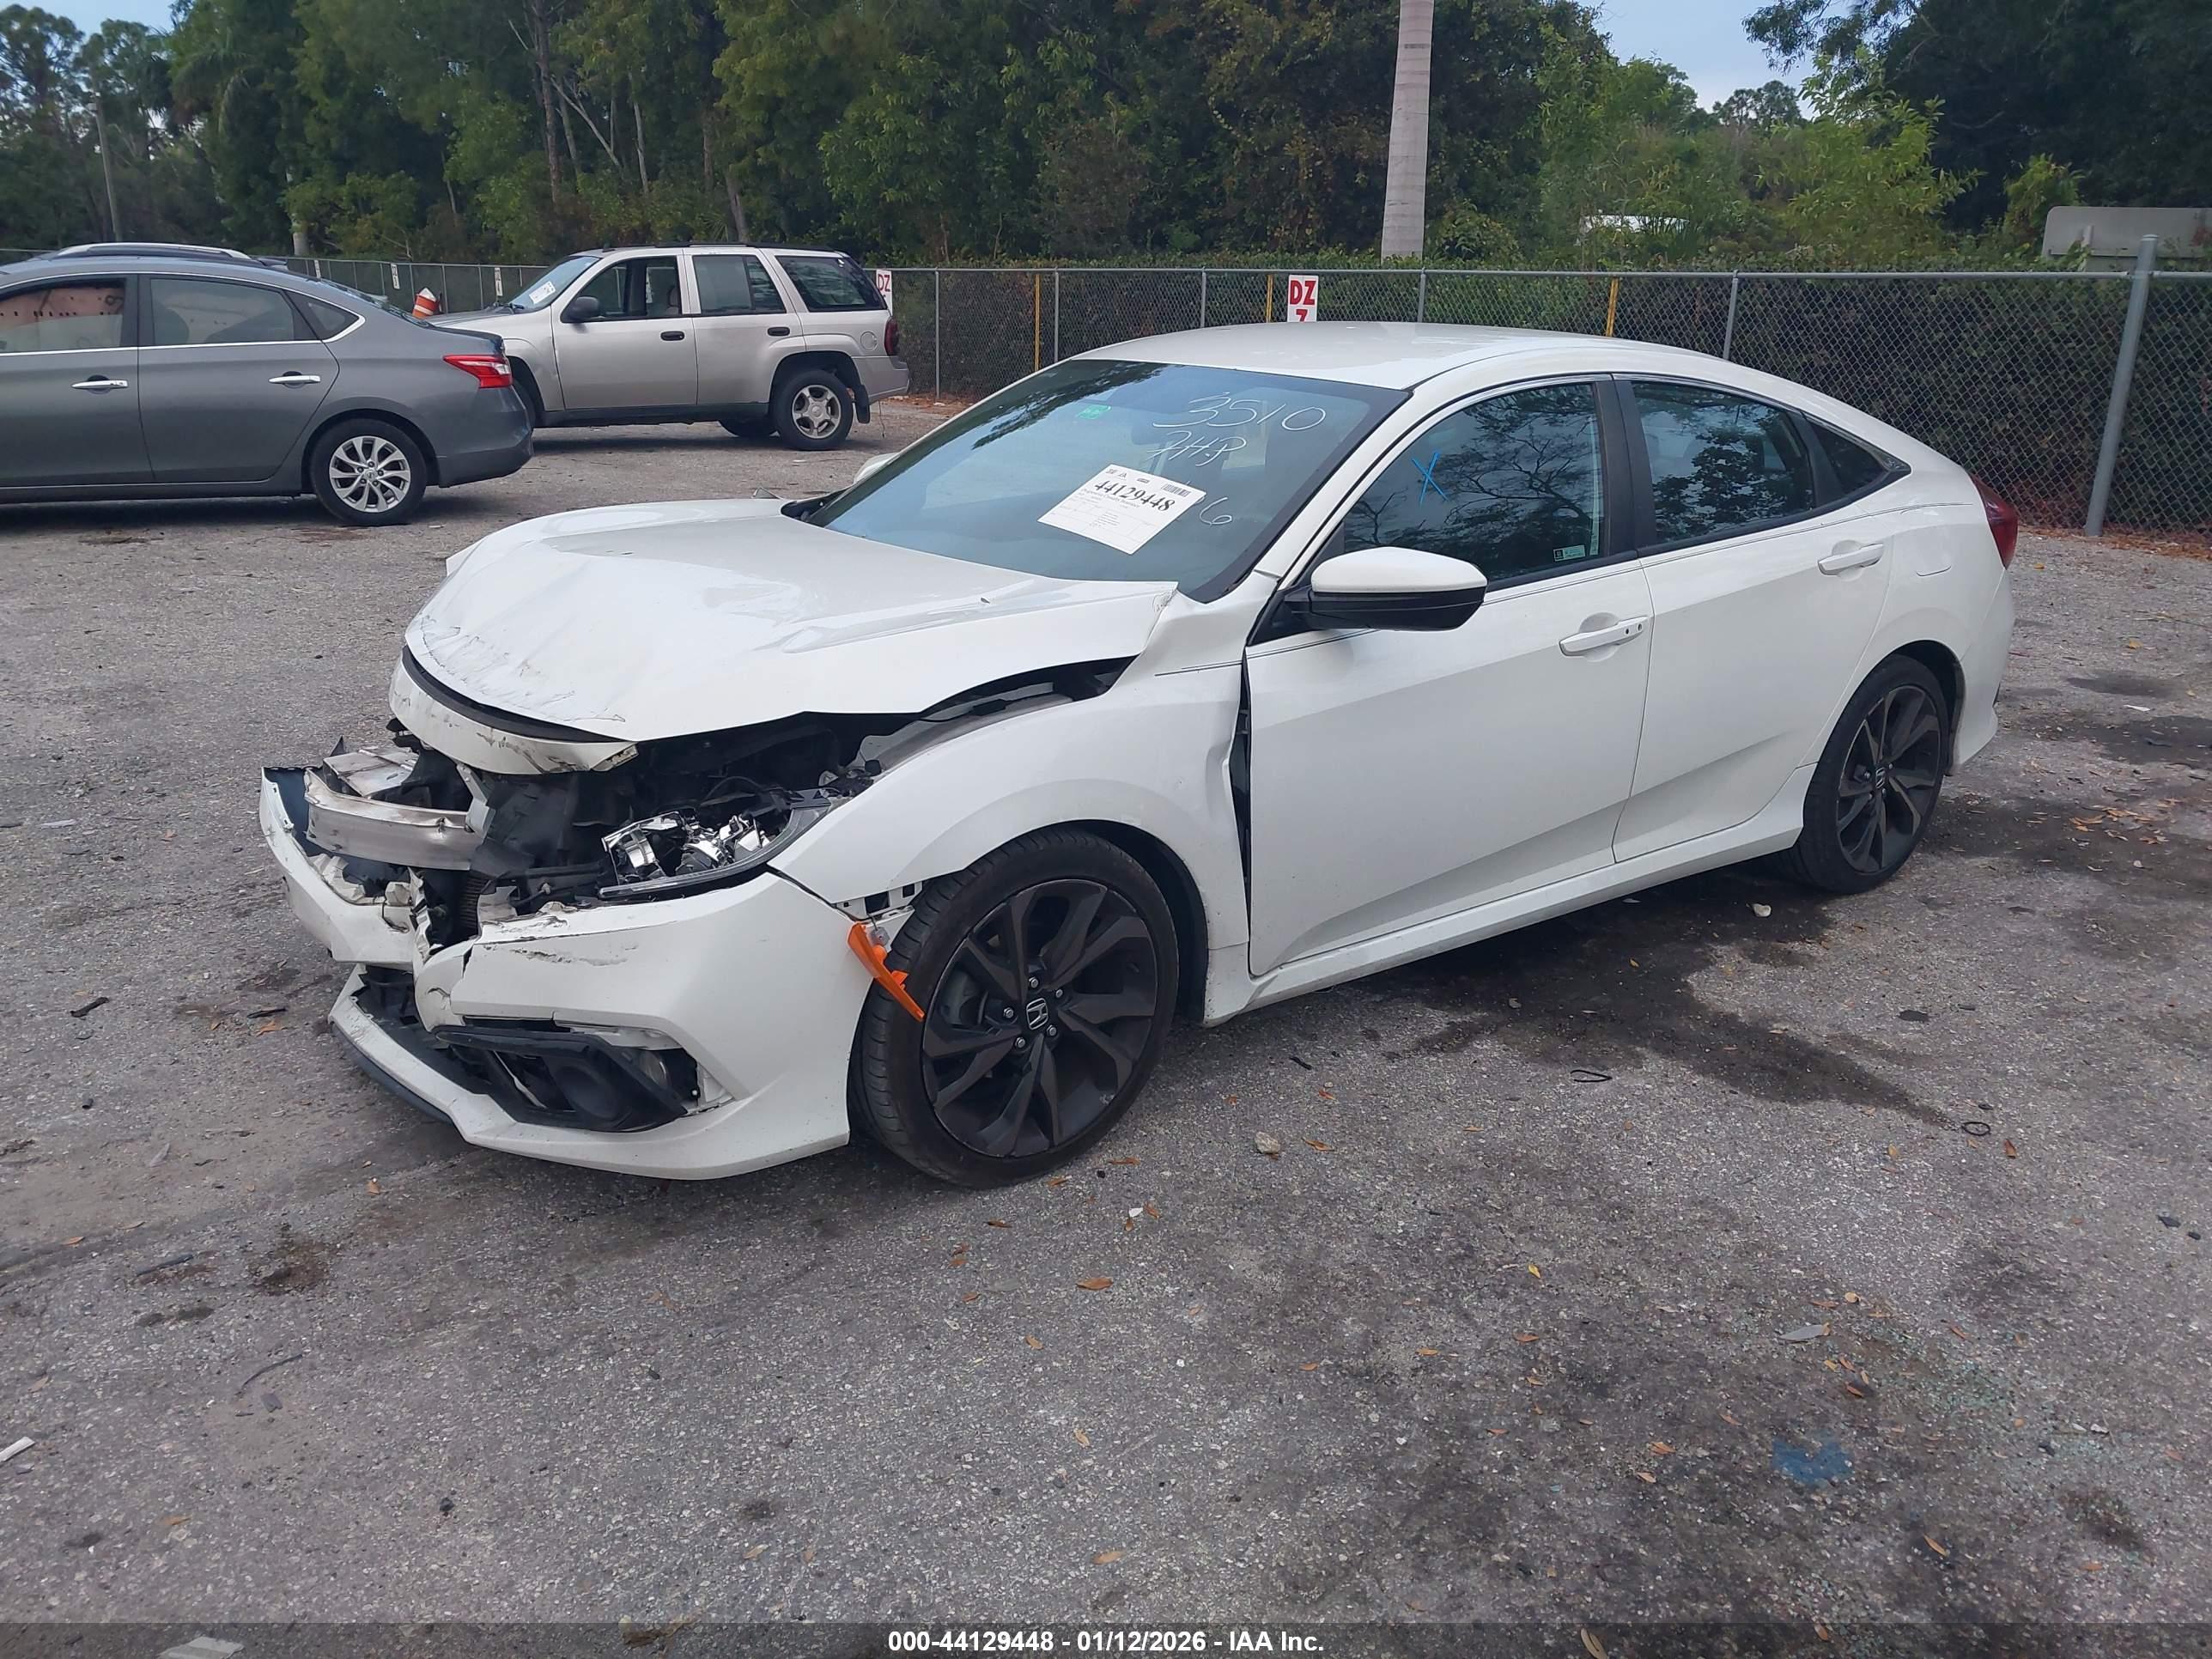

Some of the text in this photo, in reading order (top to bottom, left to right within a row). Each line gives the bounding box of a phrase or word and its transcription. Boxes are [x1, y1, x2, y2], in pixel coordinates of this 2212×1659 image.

[878, 274, 890, 292] DZ
[1290, 280, 1316, 305] DZ
[1152, 392, 1327, 431] 3510
[1093, 480, 1176, 512] 44129448
